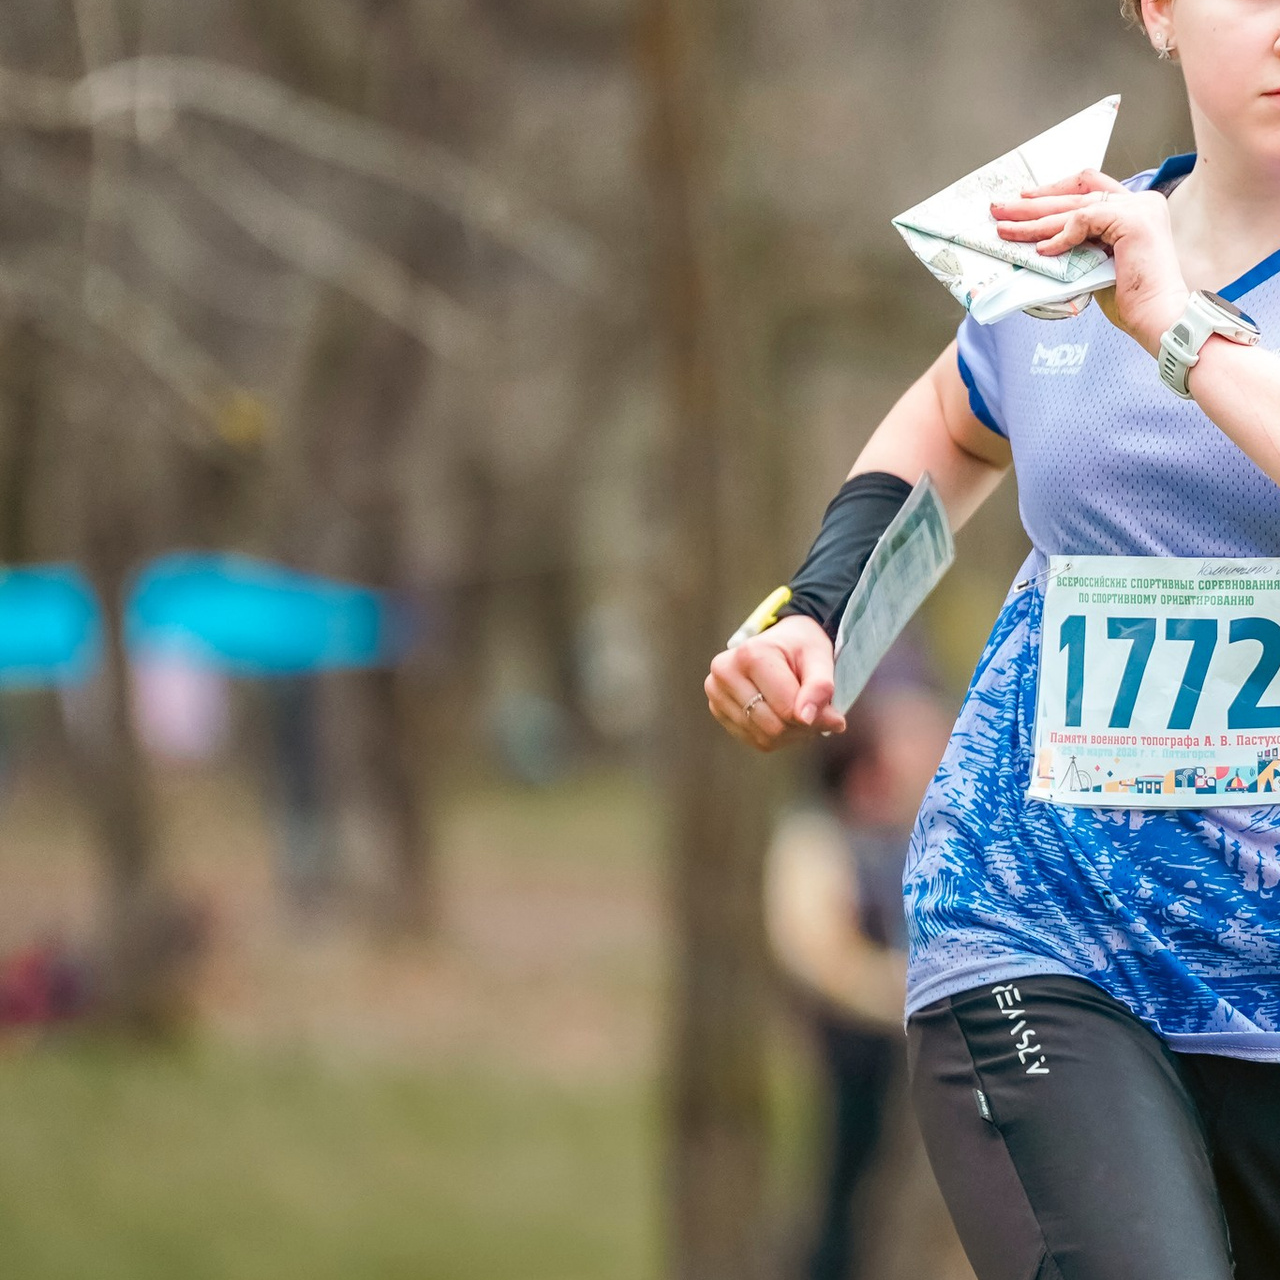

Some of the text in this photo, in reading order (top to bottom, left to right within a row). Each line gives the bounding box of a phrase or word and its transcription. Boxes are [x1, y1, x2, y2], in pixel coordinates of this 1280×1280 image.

[1056, 575, 1280, 591] ВСЕРОССИЙСКИЕ СПОРТИВНЫЕ СОРЕВНОВАНИЯ
[1078, 592, 1255, 606] ПО СПОРТИВНОМУ ОРИЕНТИРОВАНИЮ
[1050, 732, 1088, 744] Памяти
[1090, 734, 1137, 746] военного
[1140, 735, 1200, 750] топографа
[1203, 735, 1216, 747] А.
[1219, 735, 1232, 747] В.
[1161, 748, 1216, 760] Пятигорск
